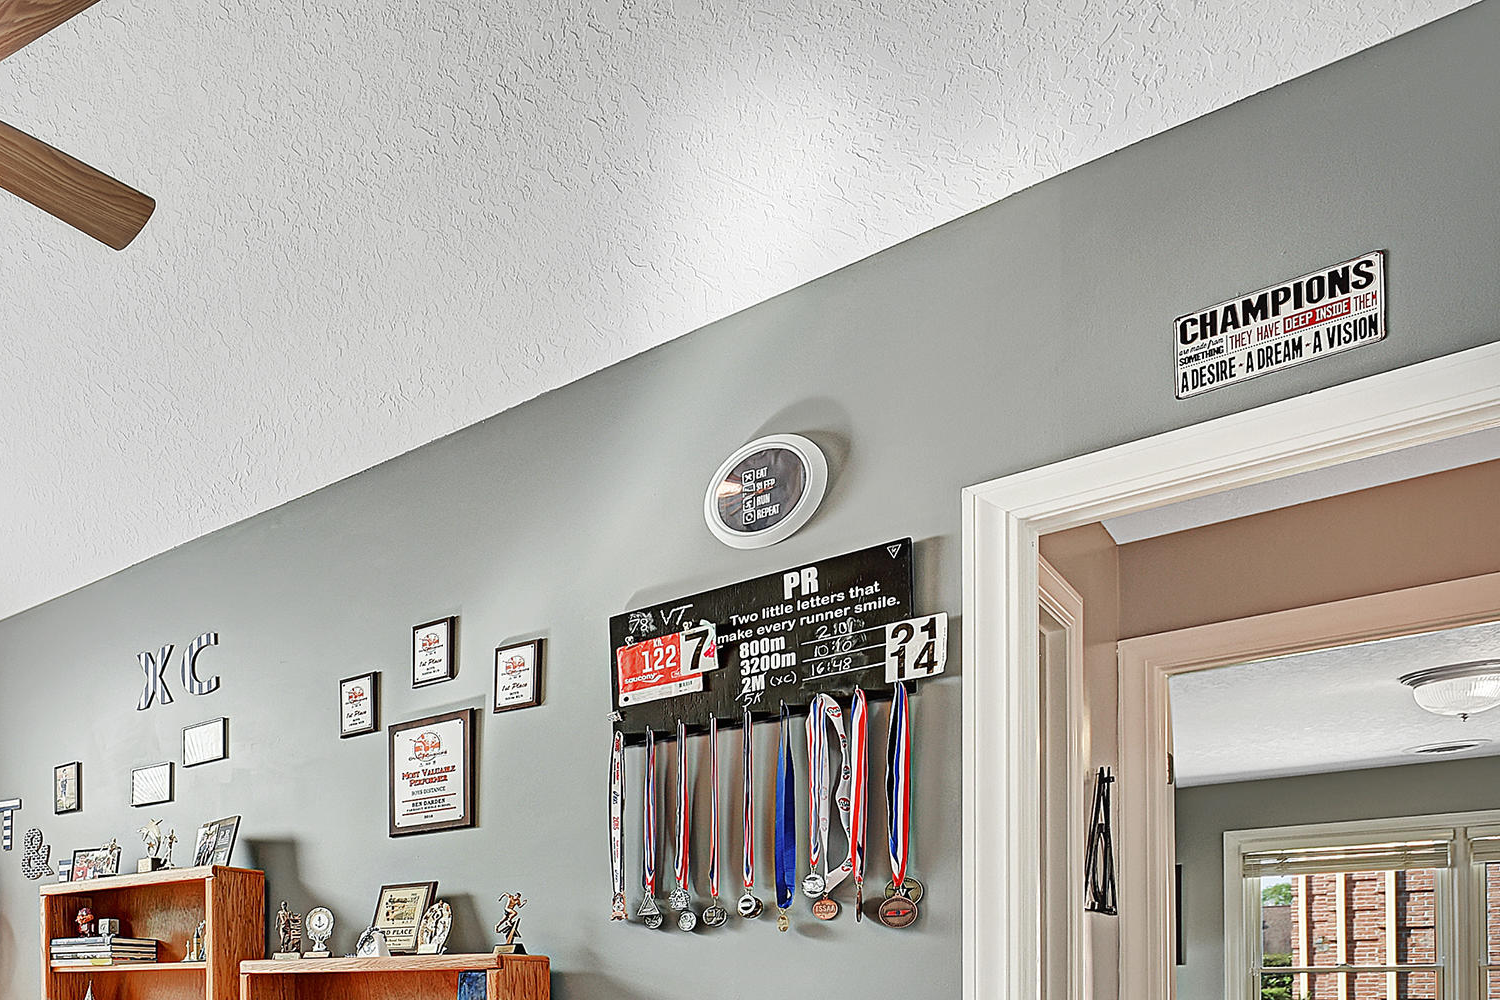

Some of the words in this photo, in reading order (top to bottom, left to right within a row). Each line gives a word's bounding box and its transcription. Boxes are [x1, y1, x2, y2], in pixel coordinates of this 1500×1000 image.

[1180, 259, 1375, 344] CHAMPIONS
[1229, 329, 1252, 350] THEY
[1257, 321, 1280, 342] HAVE
[1285, 311, 1313, 331] DEEP
[1315, 301, 1349, 321] INSIDE
[1179, 346, 1224, 366] SOMETHING
[1181, 372, 1189, 393] A
[1191, 357, 1236, 389] DESIRE
[1246, 351, 1254, 373] A
[1258, 336, 1302, 370] DREAM
[1313, 330, 1322, 353] A
[1327, 313, 1378, 349] VISION
[755, 467, 768, 479] EAT
[757, 504, 780, 520] REPEAT
[784, 566, 819, 600] PR
[730, 613, 758, 626] Two
[761, 604, 793, 619] little
[797, 591, 845, 611] letters
[849, 581, 880, 598] that
[717, 628, 752, 644] make
[757, 619, 796, 636] every
[800, 606, 851, 626] runner
[854, 596, 901, 614] smile.
[891, 617, 937, 645] 21
[642, 644, 677, 673] 122
[685, 629, 709, 670] 7
[739, 636, 786, 659] 800m
[890, 640, 938, 679] 14
[136, 632, 220, 711] XC
[625, 673, 657, 684] saucony
[739, 652, 797, 677] 3200m
[741, 673, 766, 695] 2M
